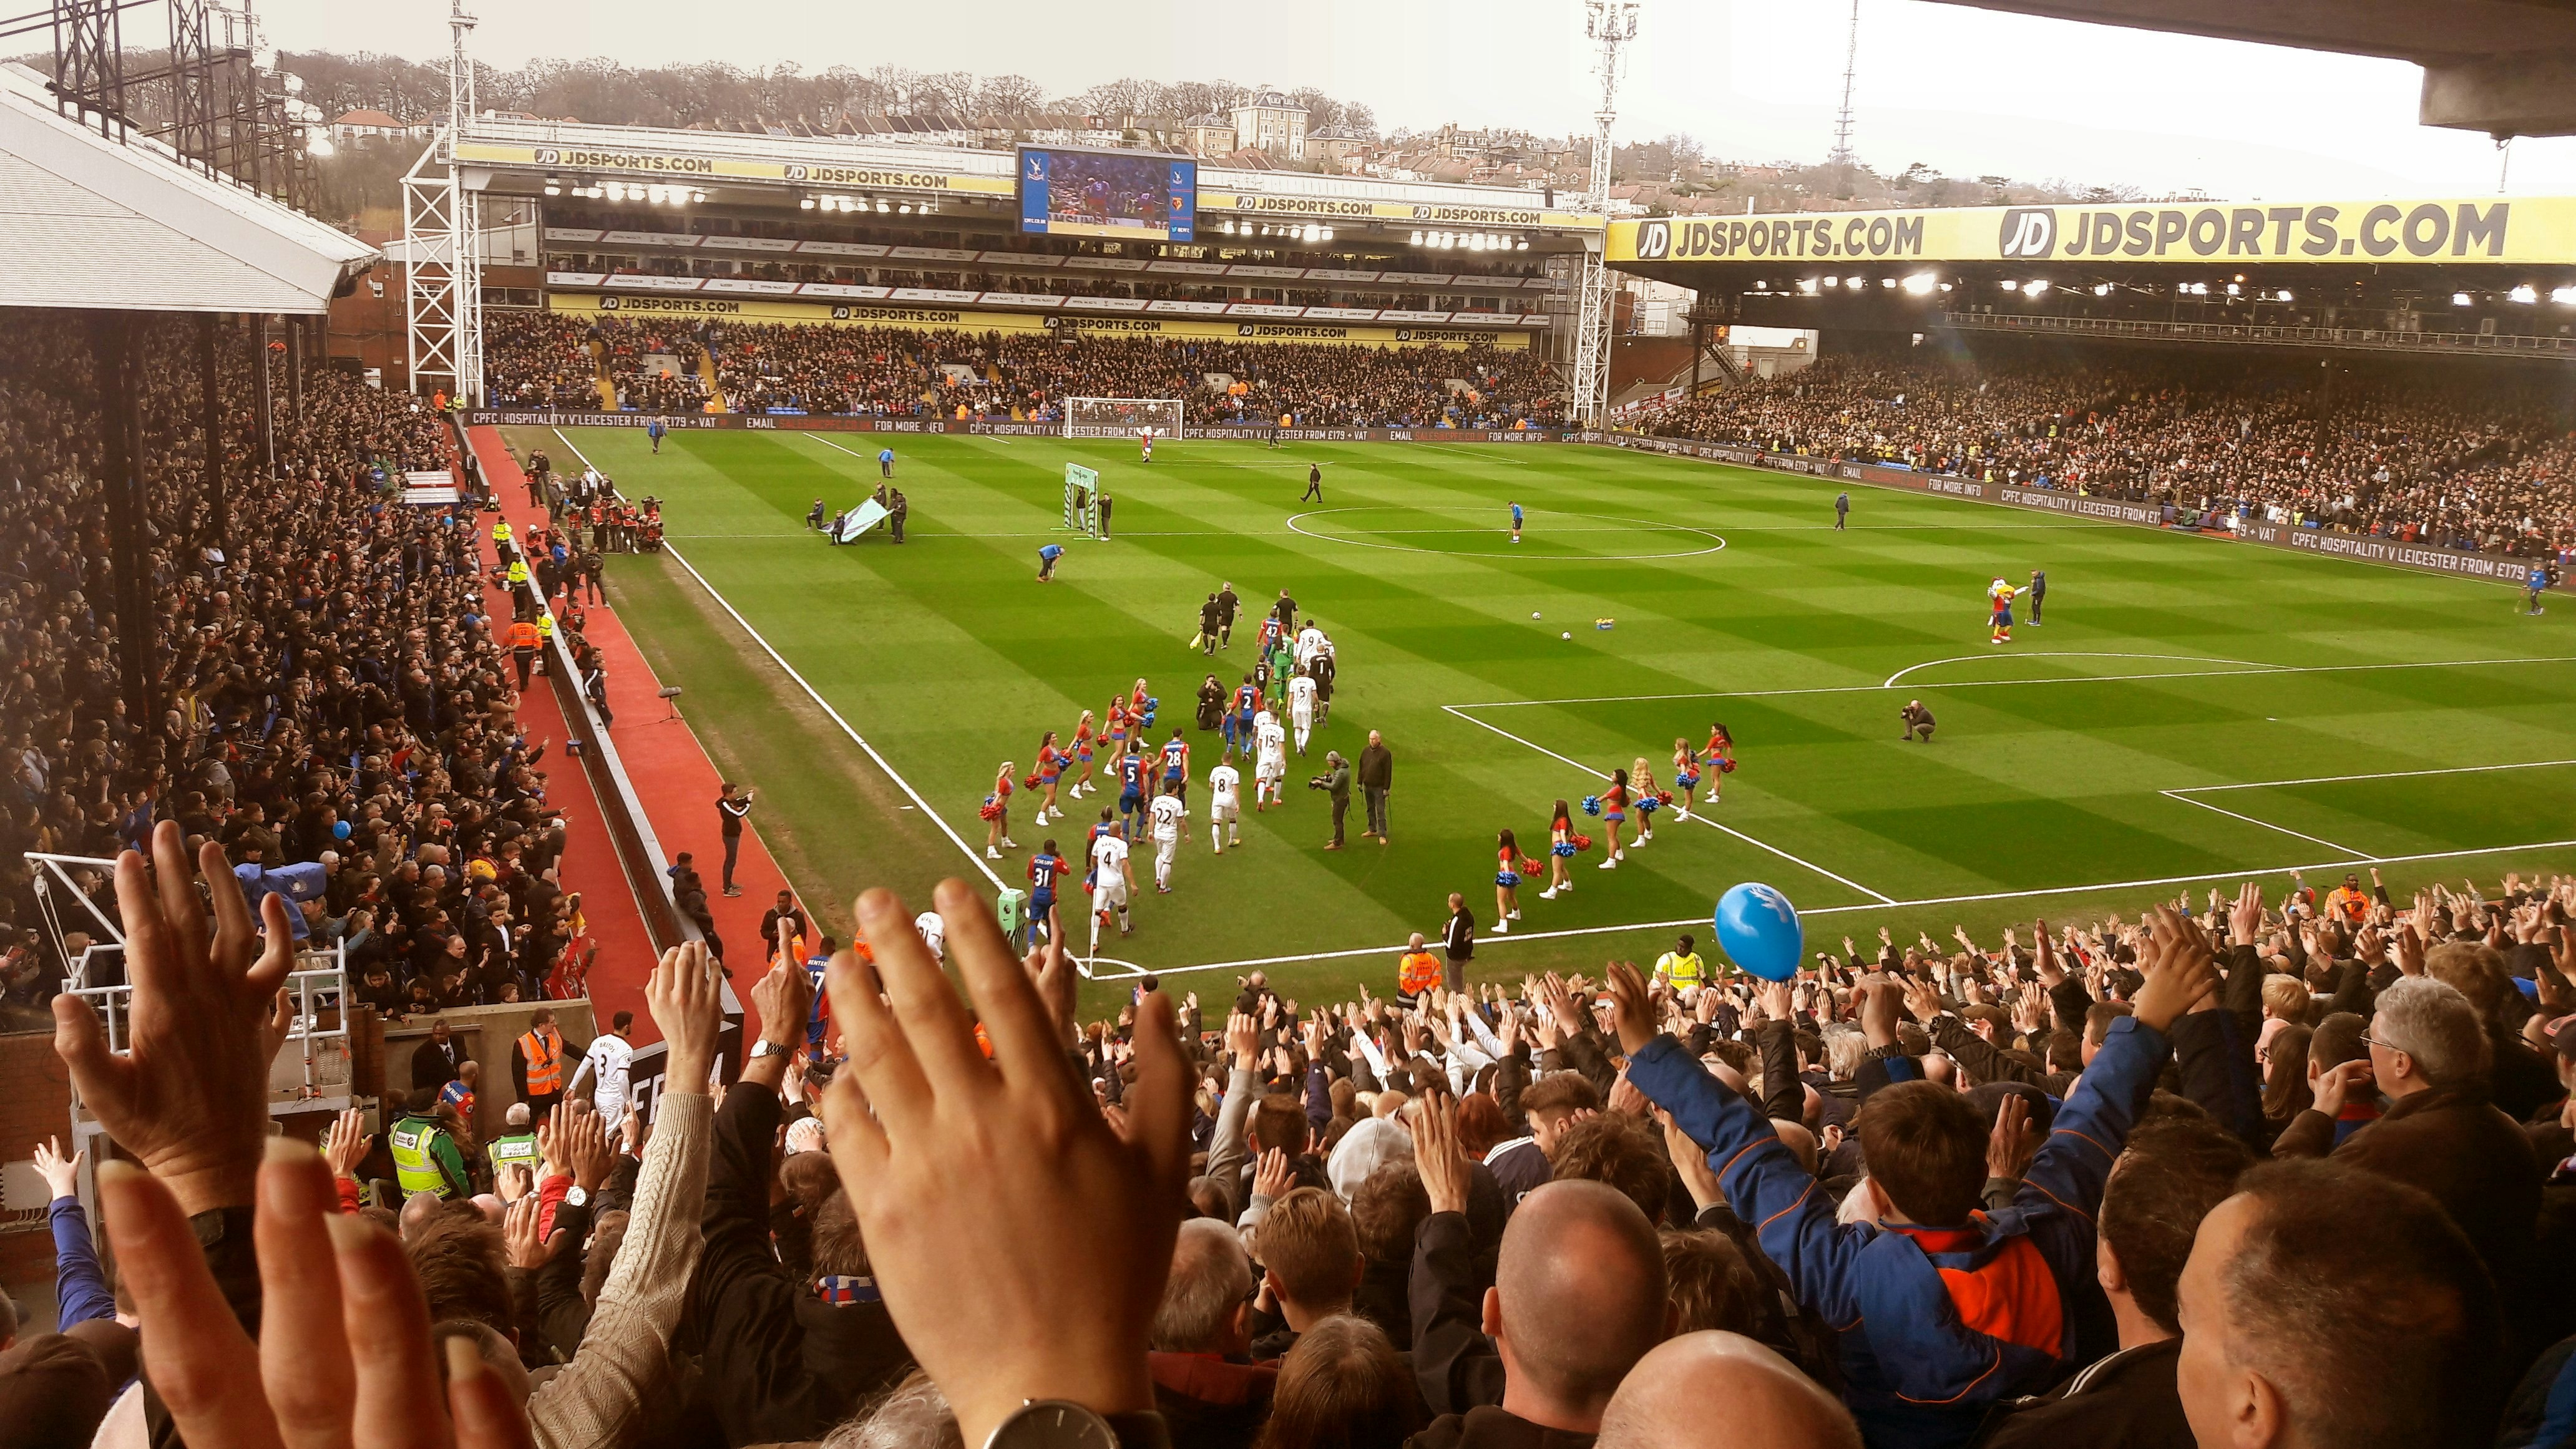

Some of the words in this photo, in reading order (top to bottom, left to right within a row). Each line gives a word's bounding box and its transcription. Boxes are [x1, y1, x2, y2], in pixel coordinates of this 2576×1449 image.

[537, 150, 557, 163] JD
[565, 151, 713, 172] JDSPORTS.COM
[786, 166, 805, 179] JD
[812, 168, 947, 188] JDSPORTS.COM
[1238, 196, 1254, 209] JD
[1259, 197, 1373, 215] JDSPORTS.COM
[1414, 205, 1431, 219] JD
[1434, 207, 1541, 224] JDSPORTS.COM
[1639, 222, 1669, 257] JD
[1676, 217, 1924, 257] JDSPORTS.COM
[2004, 212, 2051, 255] JD
[2064, 203, 2510, 256] JDSPORTS.COM
[602, 296, 618, 308] JD
[622, 298, 739, 313] JDSPORTS.COM
[833, 307, 848, 318] JD
[853, 308, 959, 323] JDSPORTS.COM
[1045, 317, 1059, 328] JD
[1068, 319, 1161, 331] SPORTS.COM
[1239, 325, 1252, 336] JD
[1256, 326, 1347, 338] JDSPORTS.COM
[1397, 329, 1409, 341] JD
[1412, 330, 1498, 343] JDSPORTS.COM
[473, 412, 497, 424] CPFC
[500, 412, 565, 426] HOSPITALITY
[568, 414, 576, 425] V
[578, 414, 631, 426] LEICESTER
[698, 417, 717, 428] VAT
[746, 417, 776, 429] EMAIL
[875, 421, 892, 431] FOR
[895, 421, 920, 432] MORE
[994, 424, 1047, 436] HOSPITALITY
[1050, 425, 1055, 436] V
[1057, 426, 1101, 436] LECESTER
[1103, 426, 1126, 437] FROM
[1184, 428, 1204, 438] CPFC
[1206, 428, 1254, 439] HOSPITALITY
[1256, 429, 1262, 439] V
[1305, 430, 1325, 440] FROM
[1328, 431, 1345, 440] £179
[1354, 431, 1367, 441] VAT
[1390, 431, 1413, 441] EMAIL
[1488, 432, 1502, 442] FOR
[1505, 432, 1523, 442] MORE
[1526, 432, 1542, 442] INFO
[1562, 432, 1579, 442] CPFC
[1699, 447, 1712, 458] CPFC
[1795, 461, 1808, 471] £179
[1815, 463, 1826, 474] VAT
[1843, 466, 1861, 479] EMAIL
[1928, 478, 1941, 490] FOR
[1943, 480, 1963, 494] MORE
[1964, 483, 1981, 497] INFO
[2001, 489, 2020, 503] CPFC
[2022, 492, 2069, 511] HOSPITALITY
[2071, 499, 2077, 512] V
[2078, 500, 2120, 519] LEICESTER
[2122, 506, 2146, 523] FROM
[2259, 526, 2276, 542] VAT
[2292, 532, 2318, 549] CPFC
[2320, 536, 2385, 559] HOSPITALITY
[2388, 546, 2395, 561] V
[2398, 548, 2457, 570] LEICESTER
[2461, 557, 2494, 575] FROM
[2496, 562, 2525, 581] £179
[1266, 626, 1277, 638] 42
[1309, 636, 1314, 646] 9
[1258, 670, 1264, 681] 8
[1319, 661, 1324, 675] 1
[1300, 686, 1305, 698] 5
[1244, 696, 1251, 709] 2
[1266, 734, 1276, 748] 15
[1166, 751, 1181, 766] 28
[1128, 767, 1135, 783] 5
[1218, 778, 1225, 793] 8
[1156, 807, 1172, 825] 22
[1104, 851, 1111, 868] 4
[1035, 867, 1050, 887] 31
[599, 1042, 615, 1053] BRITOS
[599, 1053, 607, 1078] 3
